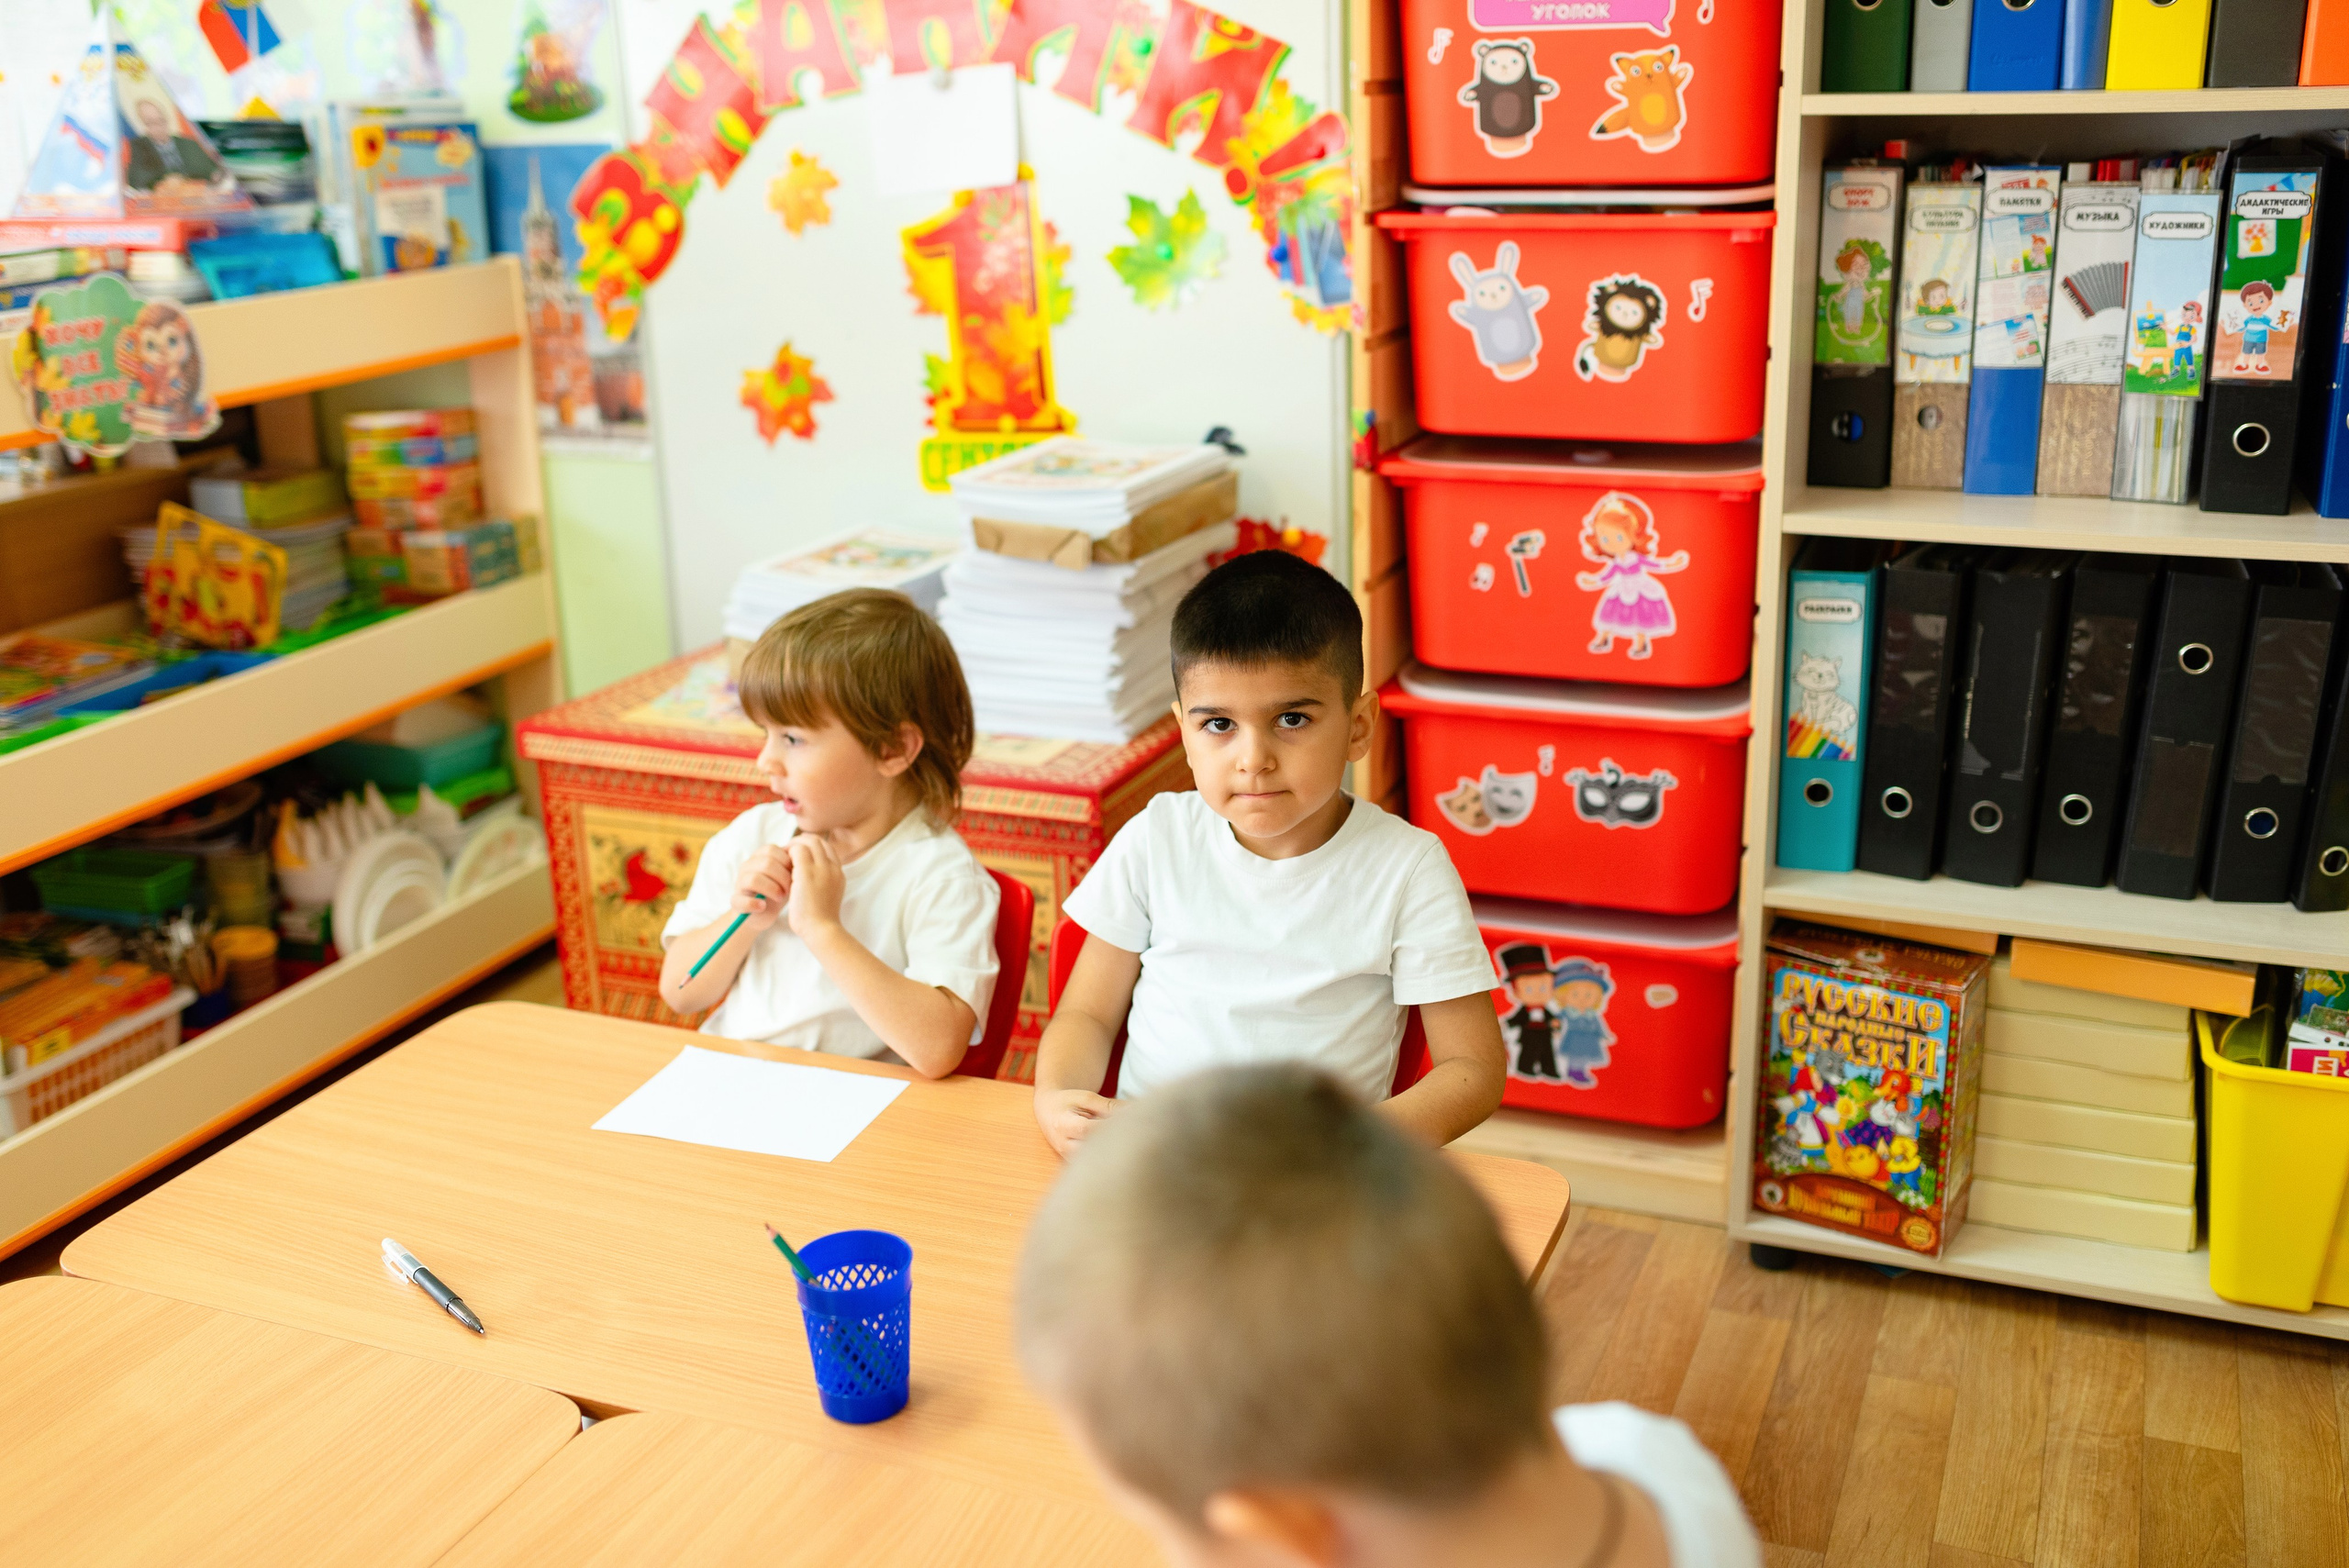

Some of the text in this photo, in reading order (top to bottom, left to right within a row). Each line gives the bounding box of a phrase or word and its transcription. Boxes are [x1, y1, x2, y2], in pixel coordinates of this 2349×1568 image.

[1531, 3, 1611, 21] УГОЛОК
[1999, 196, 2043, 206] ПАМЯТКИ
[2239, 198, 2310, 207] ДИДАКТИЧЕСКИЕ
[2076, 211, 2120, 222] МУЗЫКА
[2261, 207, 2284, 216] ИГРЫ
[2148, 221, 2206, 230] ХУДОЖНИКИ
[903, 167, 1077, 433] 1
[1782, 972, 1943, 1033] РУССКИЕ
[1778, 1007, 1942, 1081] СКАЗКИ
